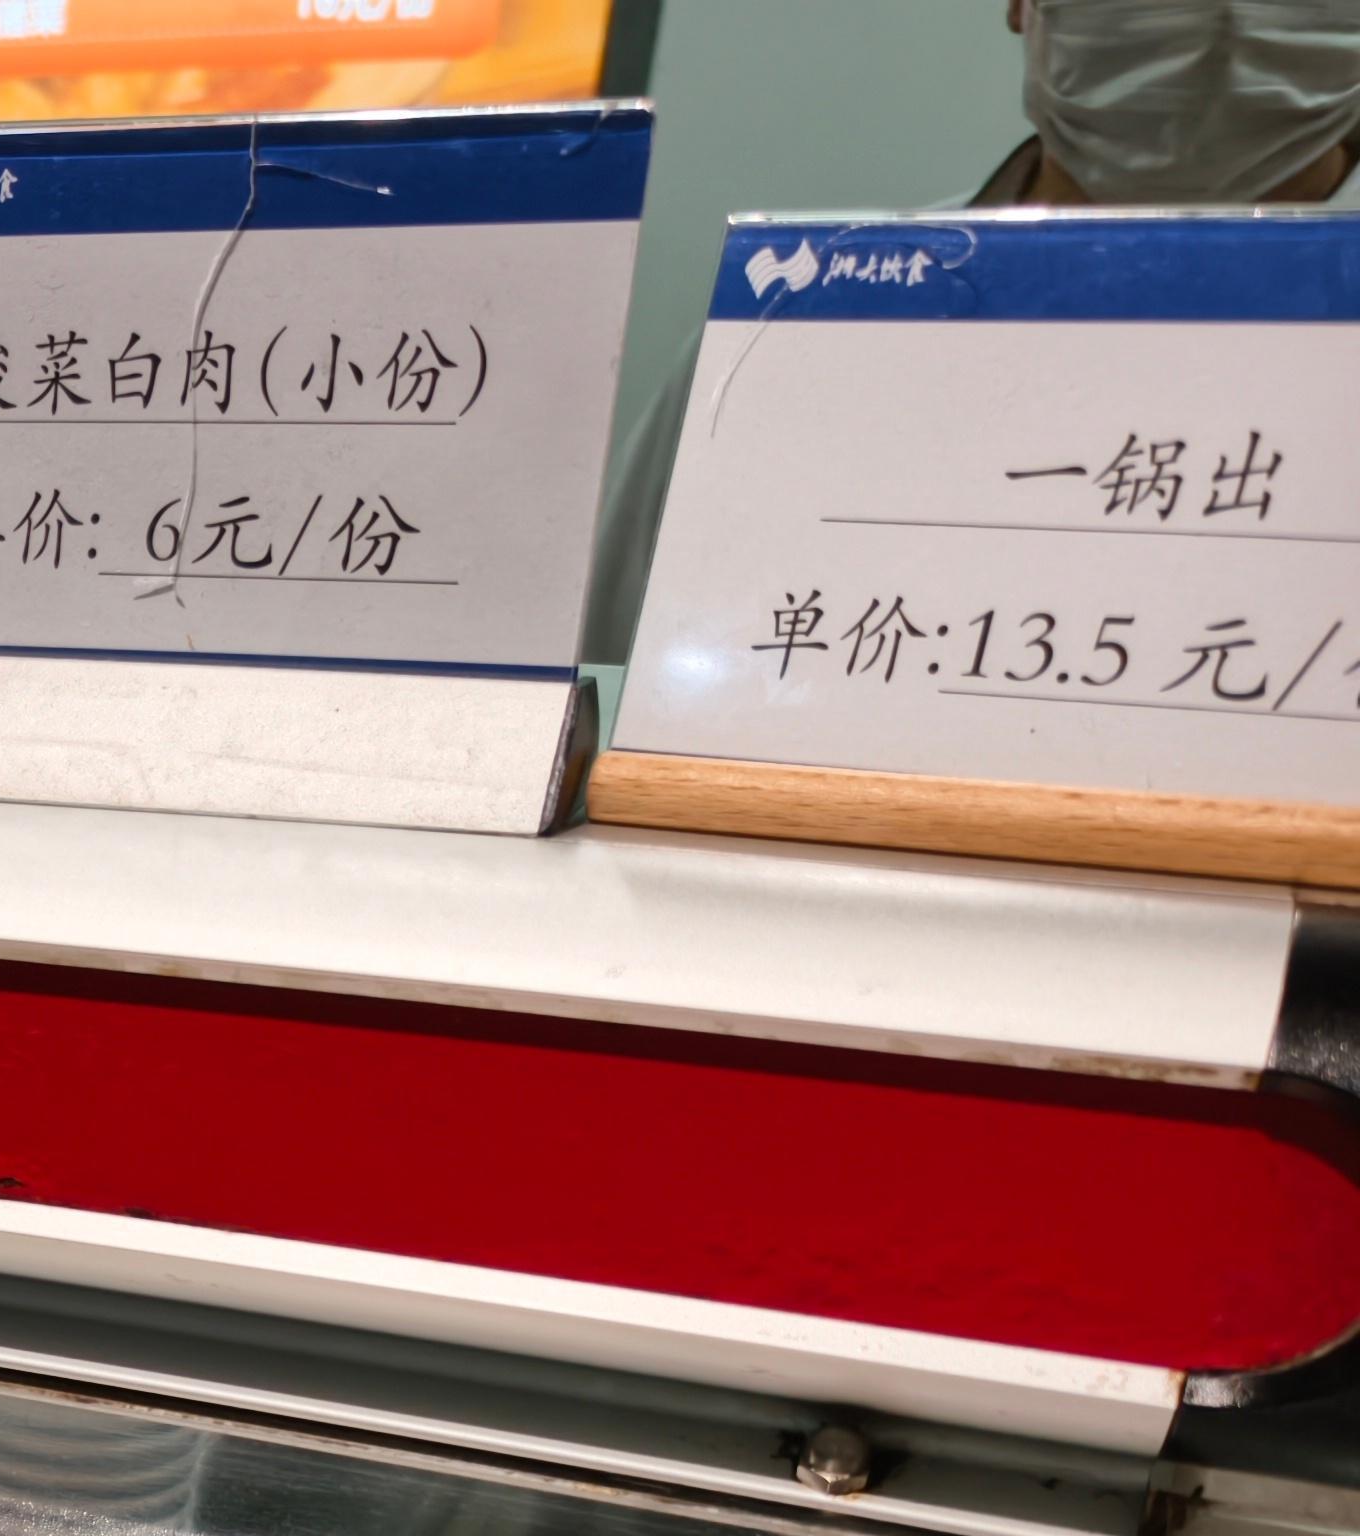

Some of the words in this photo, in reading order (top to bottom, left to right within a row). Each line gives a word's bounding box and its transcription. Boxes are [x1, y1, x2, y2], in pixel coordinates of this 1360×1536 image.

[1004, 430, 1284, 521] 一锅出
[750, 588, 1360, 712] 单价:13.5元/
